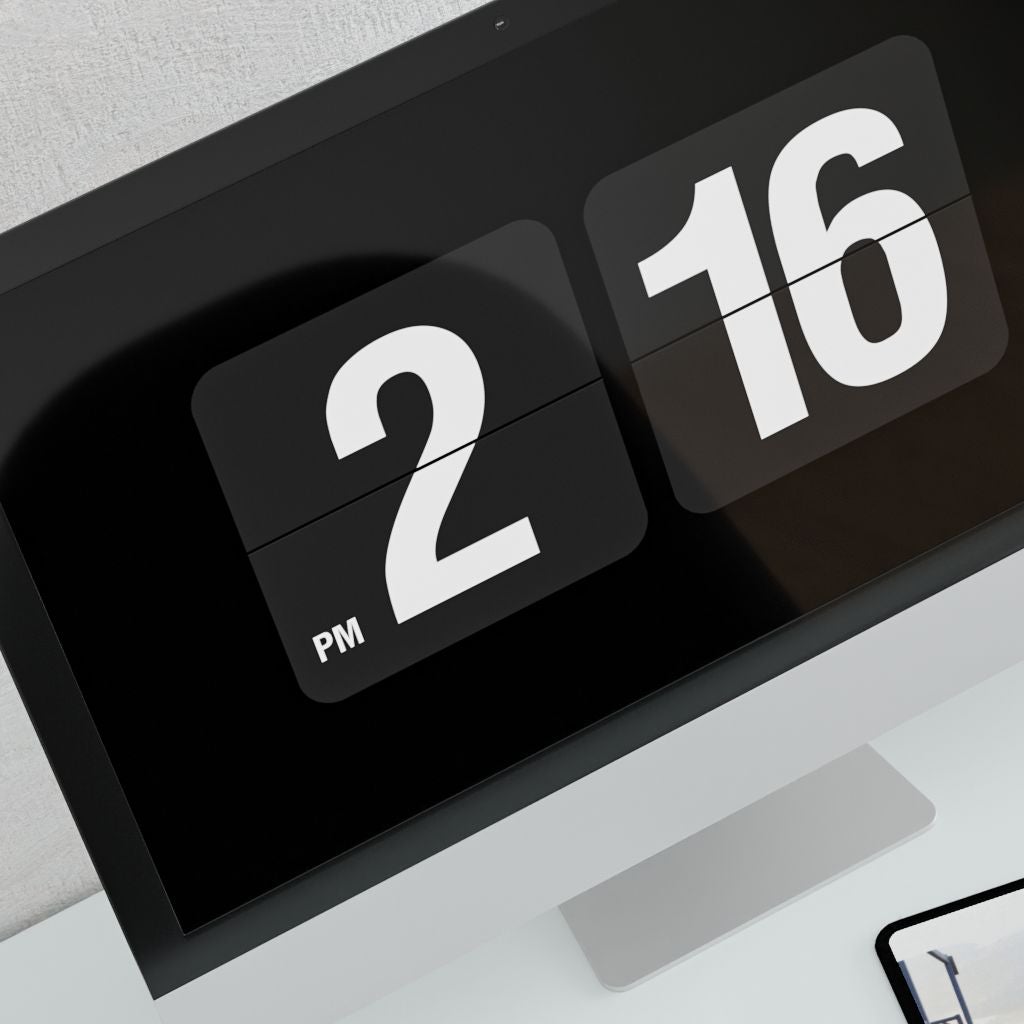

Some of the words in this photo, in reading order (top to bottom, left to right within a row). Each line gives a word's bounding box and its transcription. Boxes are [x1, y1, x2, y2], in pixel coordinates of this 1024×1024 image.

[325, 326, 540, 625] 2
[638, 108, 947, 439] 16
[313, 617, 364, 663] PM
